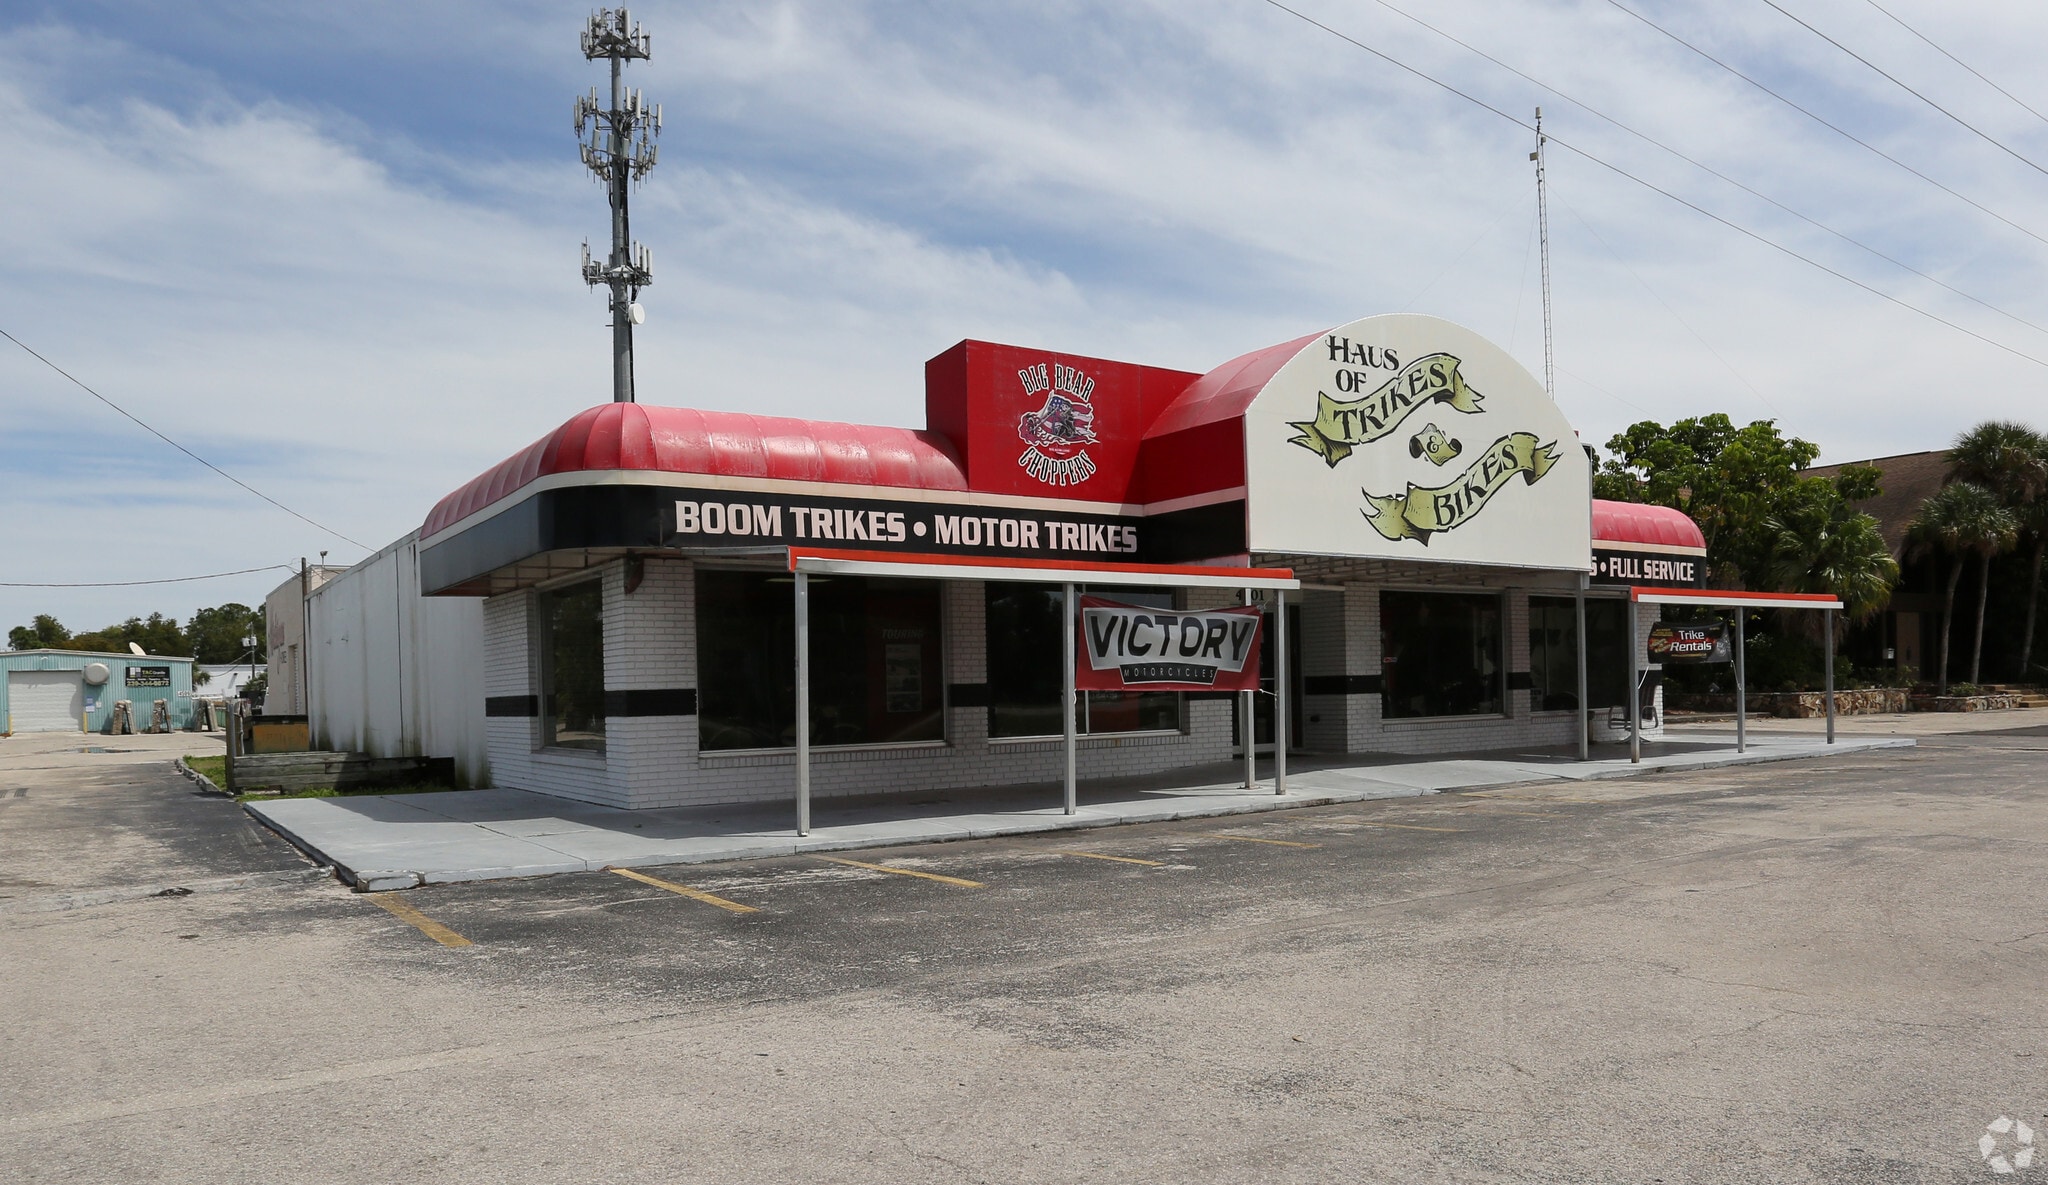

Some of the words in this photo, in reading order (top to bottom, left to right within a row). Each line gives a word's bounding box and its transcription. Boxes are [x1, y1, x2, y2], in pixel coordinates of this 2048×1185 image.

[1325, 335, 1400, 371] HAUS
[1018, 363, 1049, 396] BIG
[1055, 363, 1095, 403] BEAR
[1335, 368, 1367, 394] OF
[1333, 362, 1448, 440] TRIKES
[1428, 434, 1444, 454] &
[1018, 446, 1096, 486] CHOPPERS
[1433, 444, 1519, 527] BIKES
[675, 500, 783, 537] BOOM
[789, 506, 906, 542] TRIKES
[934, 514, 1040, 549] MOTOR
[1044, 521, 1138, 553] TRIKES
[1609, 557, 1642, 579] FULL
[1643, 560, 1695, 582] SERVICE
[1236, 589, 1265, 601] 401
[1090, 615, 1250, 661] VICTORY
[1670, 641, 1712, 652] Rentals
[1679, 630, 1705, 640] Trike
[1124, 667, 1214, 678] MOTORCYCLES
